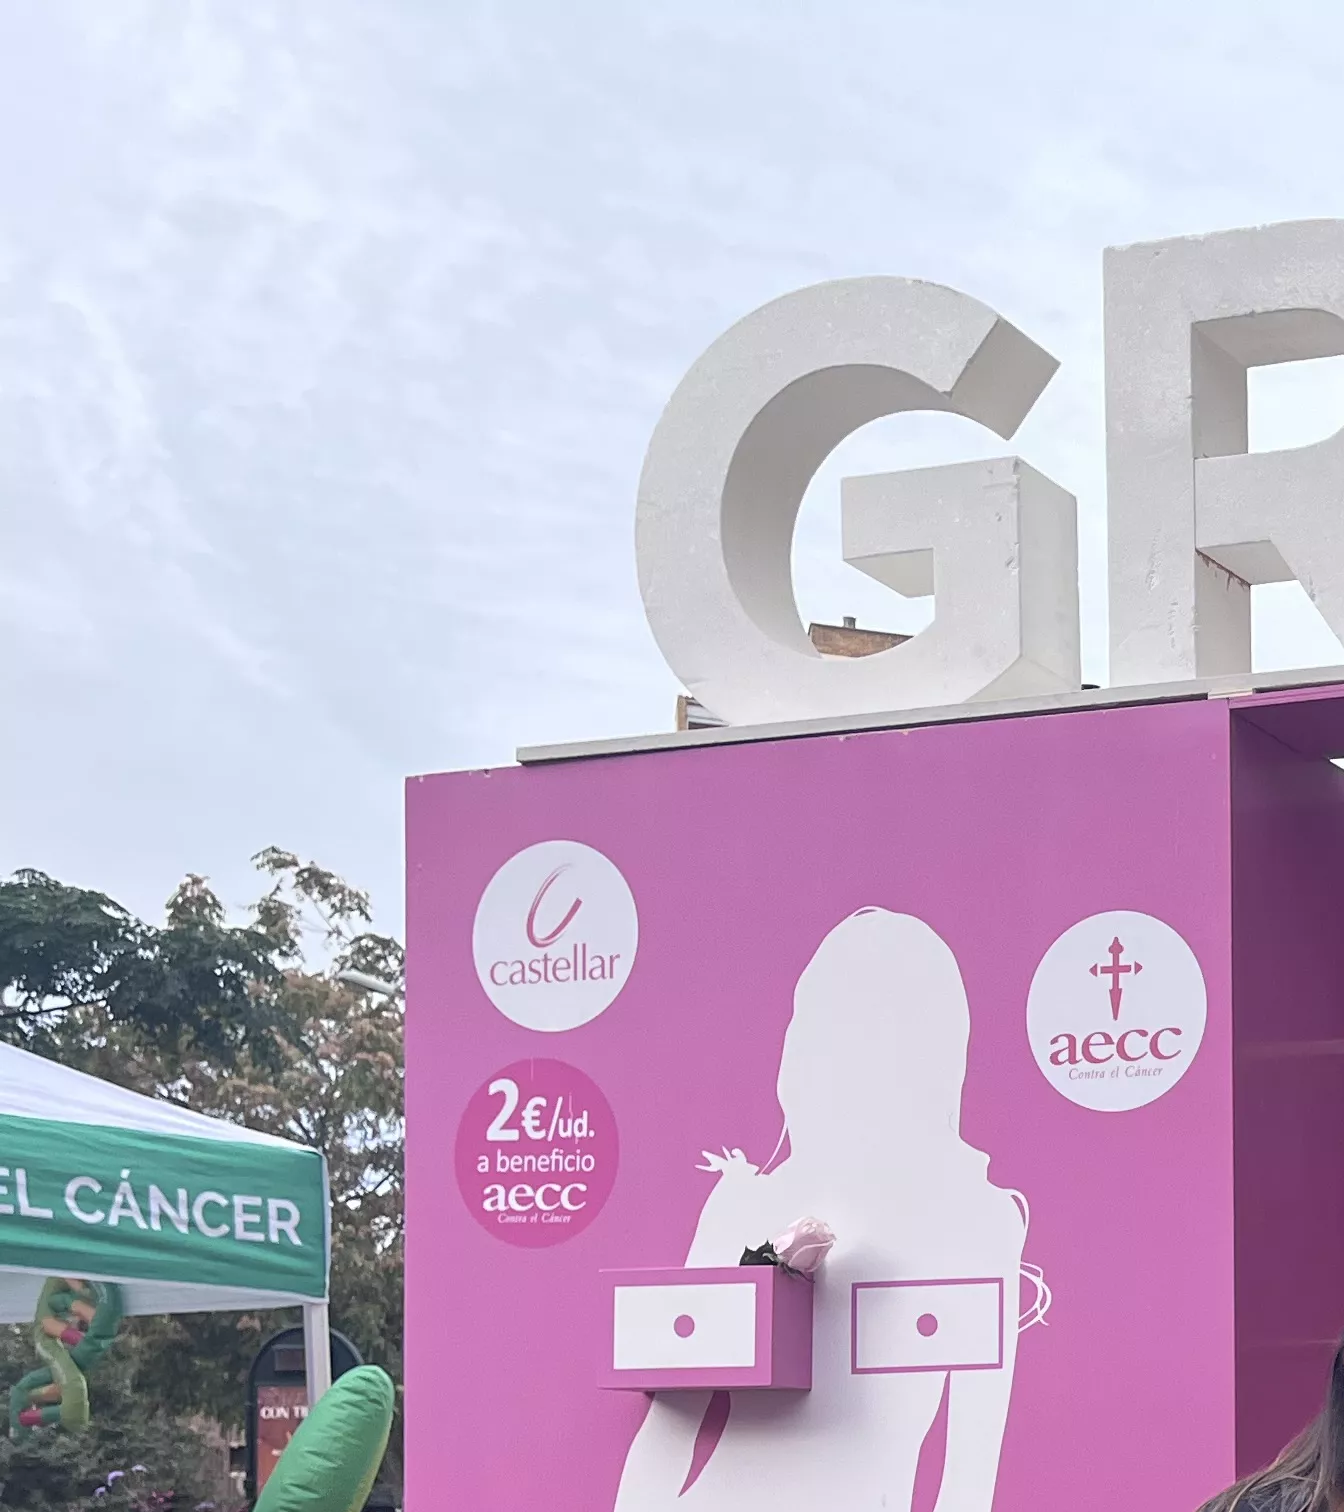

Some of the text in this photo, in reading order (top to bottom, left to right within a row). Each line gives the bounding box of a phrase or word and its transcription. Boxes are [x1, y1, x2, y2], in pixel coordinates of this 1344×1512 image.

[489, 943, 620, 986] castellar
[1049, 1027, 1182, 1066] aecc
[1068, 1065, 1164, 1081] Contra el Cáncer
[486, 1078, 595, 1142] 2€/ud.
[477, 1148, 596, 1173] a beneficio
[64, 1168, 303, 1247] CÁNCER
[482, 1183, 588, 1212] aecc
